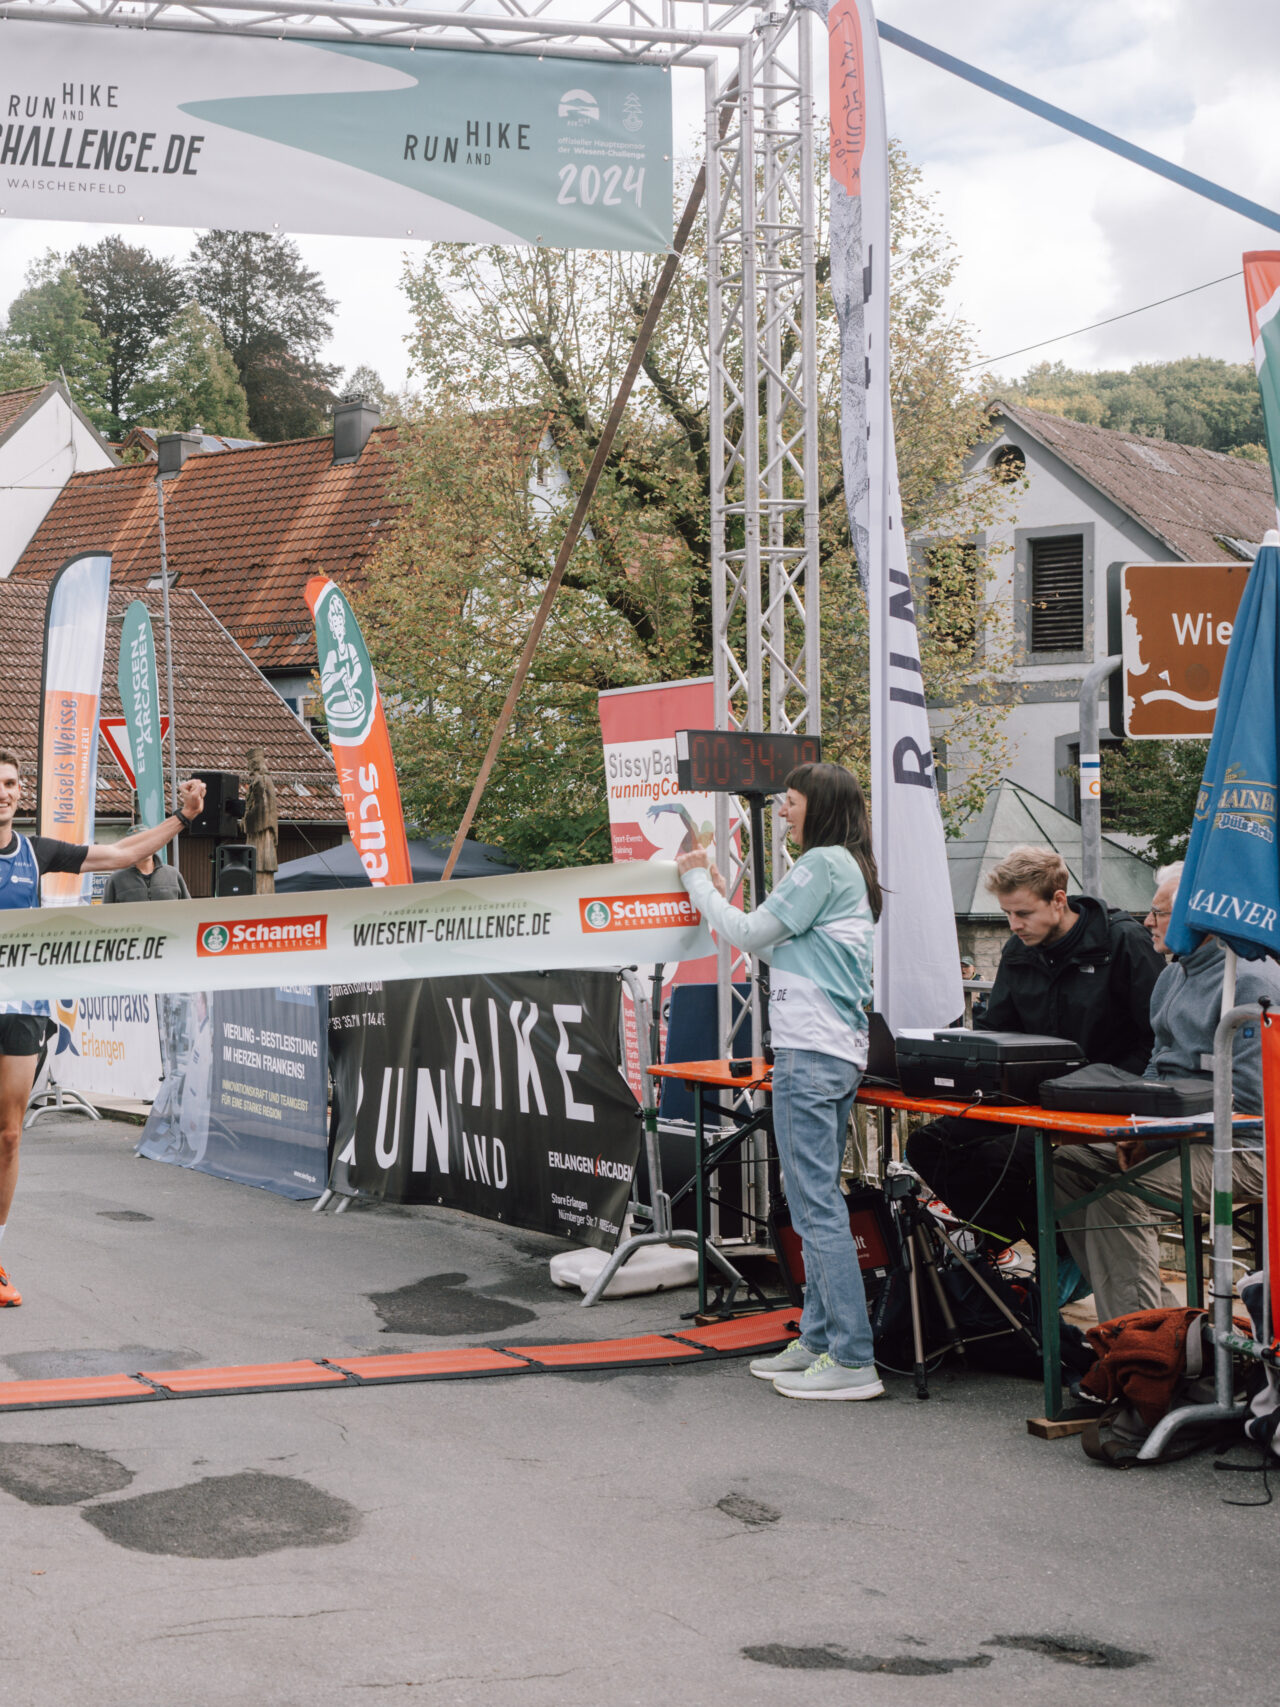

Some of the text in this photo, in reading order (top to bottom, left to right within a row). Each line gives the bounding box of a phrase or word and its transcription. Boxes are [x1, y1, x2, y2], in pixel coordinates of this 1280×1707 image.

[8, 83, 118, 119] RUN HIKE
[62, 110, 84, 121] AND
[403, 120, 530, 163] RUN HIKE
[466, 153, 491, 166] AND
[7, 178, 127, 195] WAISCHENFELD
[557, 163, 646, 208] 2024
[1171, 612, 1234, 646] Wie
[138, 622, 154, 744] ARCADEN
[131, 639, 147, 774] ERLANGEN
[53, 699, 78, 823] Maisel's Weisse
[358, 762, 389, 887] Scha
[232, 920, 321, 942] Schamel
[232, 938, 321, 950] MEERRETTICH
[353, 912, 552, 947] WIESENT-CHALLENGE.DE
[81, 1031, 126, 1066] Erlangen
[223, 1022, 255, 1044] VIERLING
[261, 1030, 318, 1058] BESTLEISTUNG
[223, 1045, 306, 1080] IM HERZEN FRANKENS!
[446, 997, 595, 1122] HIKE
[462, 1131, 508, 1189] AND
[548, 1151, 634, 1183] ERLANGEN ARCADEN
[551, 1193, 588, 1211] Store Erlangen
[558, 1209, 585, 1226] Nürnberger
